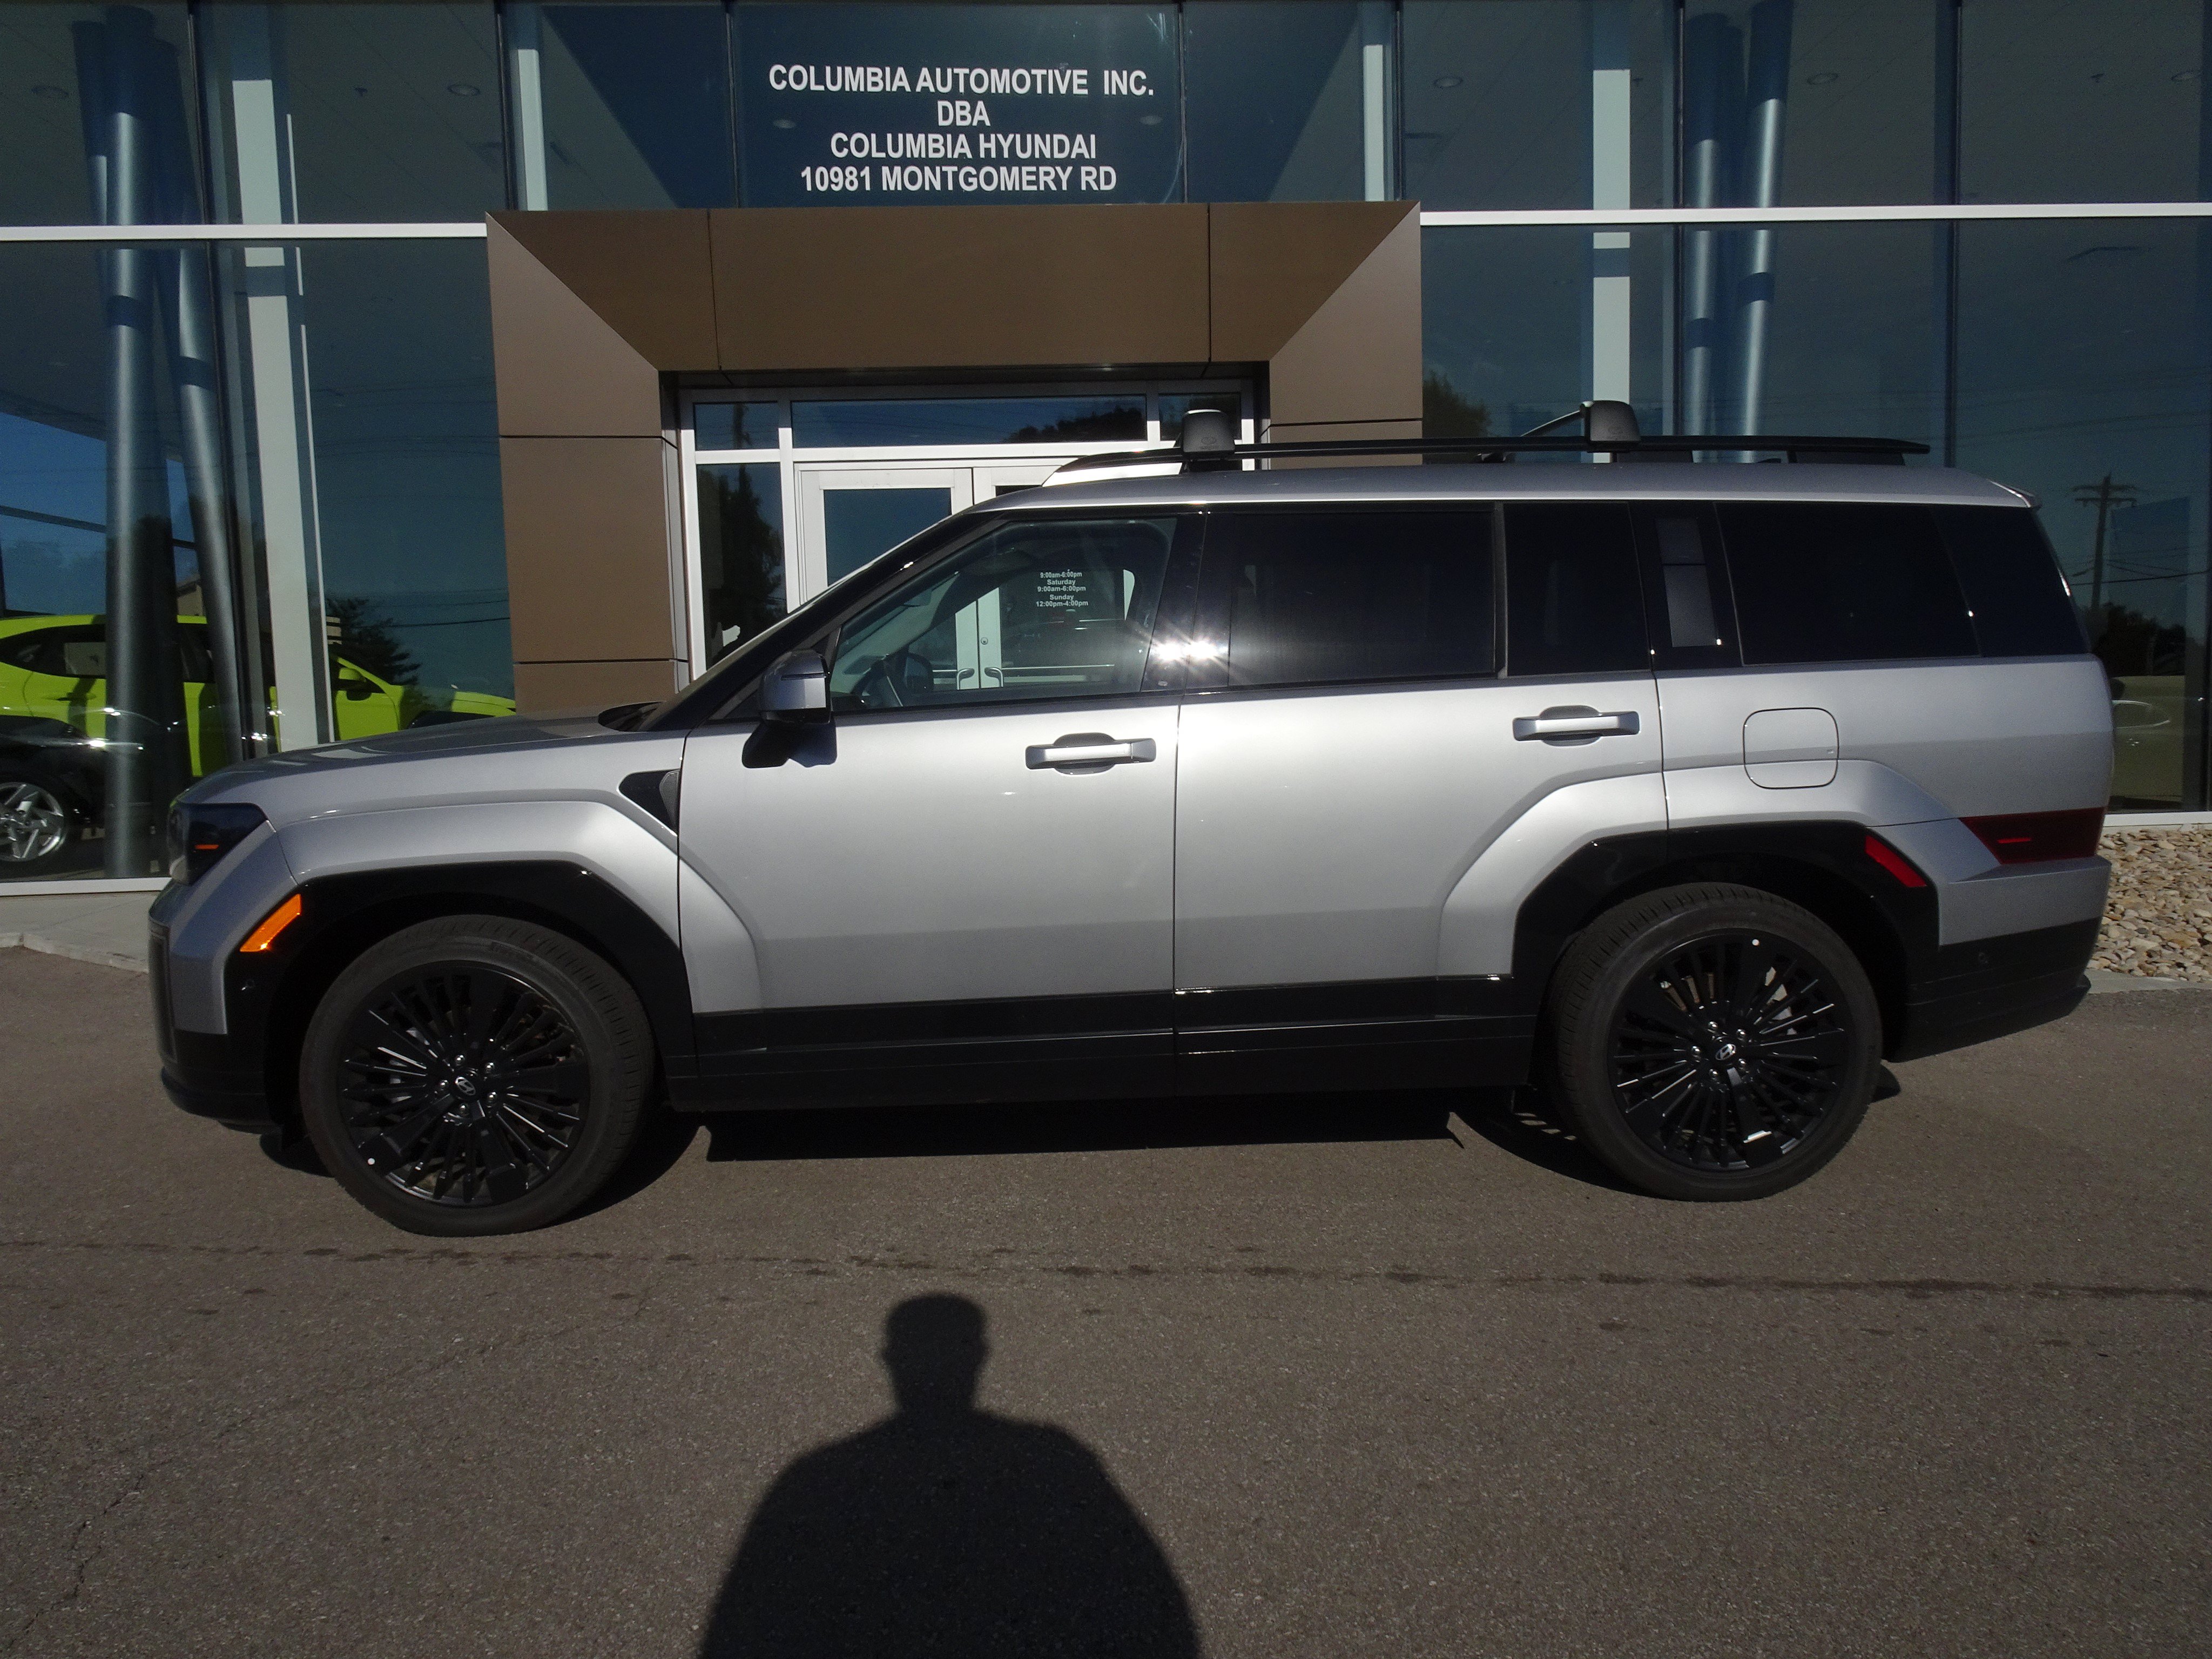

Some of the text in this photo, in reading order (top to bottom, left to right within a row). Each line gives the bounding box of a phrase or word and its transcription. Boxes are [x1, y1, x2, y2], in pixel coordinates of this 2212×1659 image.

[769, 64, 1154, 96] COLUMBIA AUTOMOTIVE INC.
[937, 100, 991, 126] DBA
[831, 132, 1096, 159] COLUMBIA HYUNDAI
[801, 166, 1117, 192] 10981 MONTGOMERY RD
